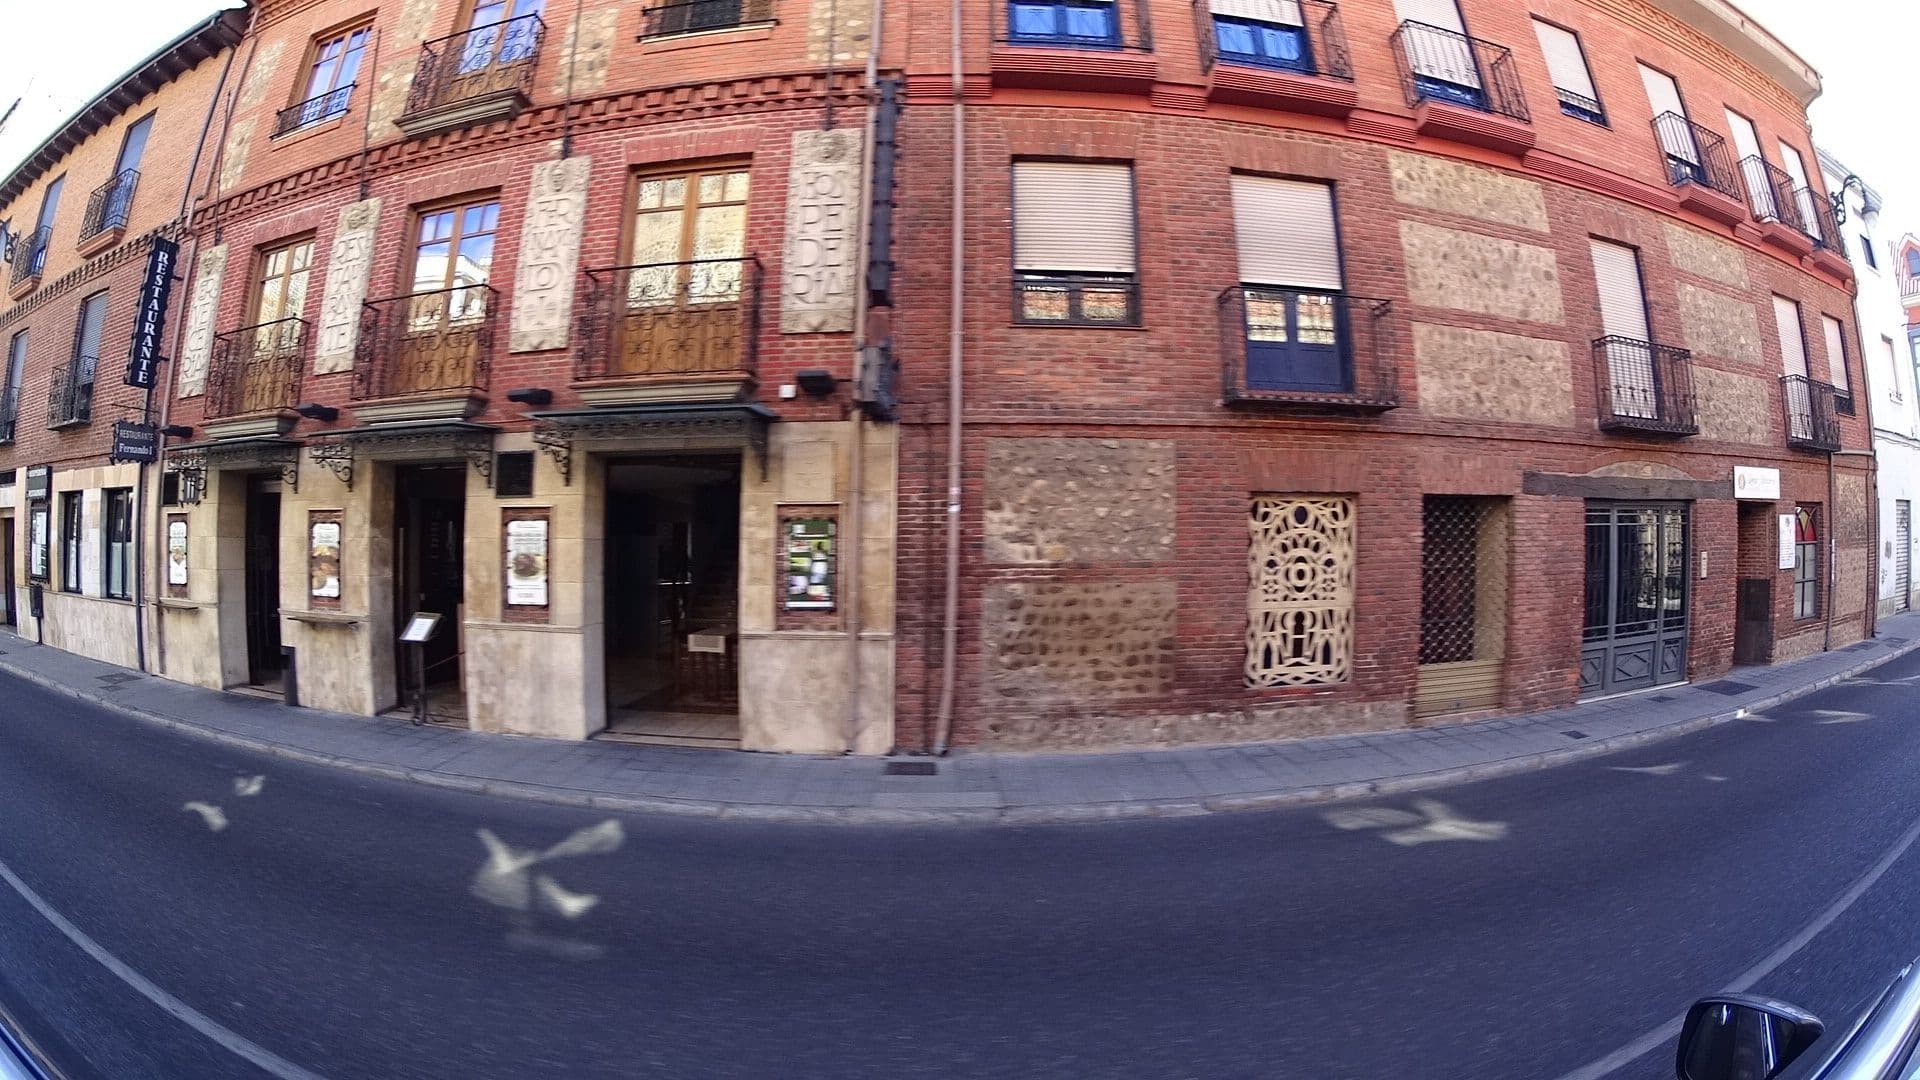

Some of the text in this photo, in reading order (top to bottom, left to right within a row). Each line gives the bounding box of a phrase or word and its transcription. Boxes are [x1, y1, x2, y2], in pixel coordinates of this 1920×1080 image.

[137, 251, 169, 384] RESTAURANTE
[119, 429, 154, 441] RESTAURANTE
[119, 443, 149, 455] Fernando
